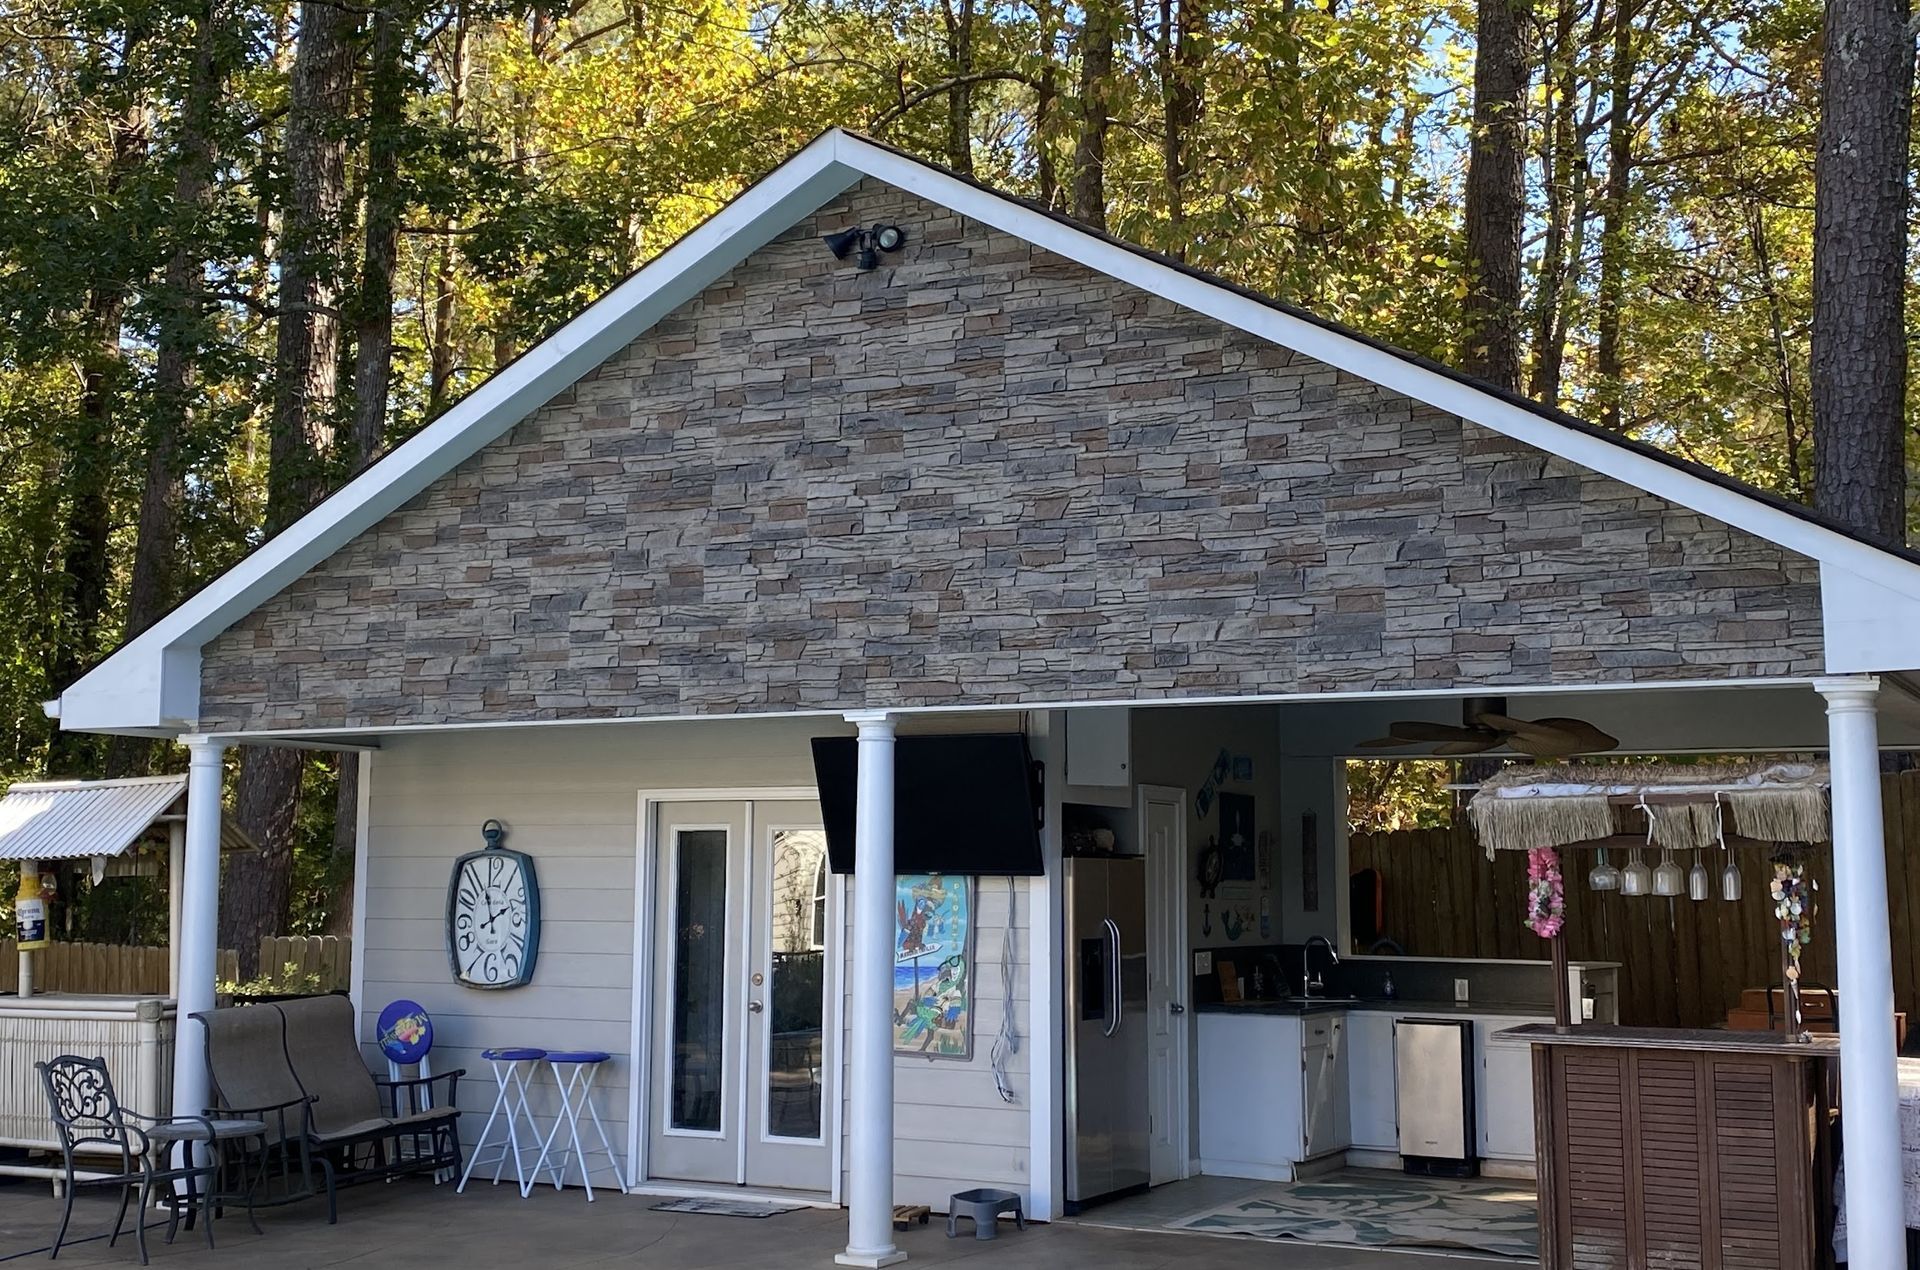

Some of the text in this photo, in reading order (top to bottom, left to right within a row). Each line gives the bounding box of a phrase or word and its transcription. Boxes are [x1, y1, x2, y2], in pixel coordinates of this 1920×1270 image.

[464, 860, 485, 899] 11
[487, 856, 504, 889] 12
[503, 862, 519, 895] 1
[458, 888, 476, 912] 10
[509, 887, 526, 912] 2
[457, 913, 473, 930] 9
[511, 911, 527, 928] 3
[458, 931, 475, 952] 8
[466, 943, 486, 977] 7
[483, 952, 498, 983] 6
[500, 942, 519, 979] 5
